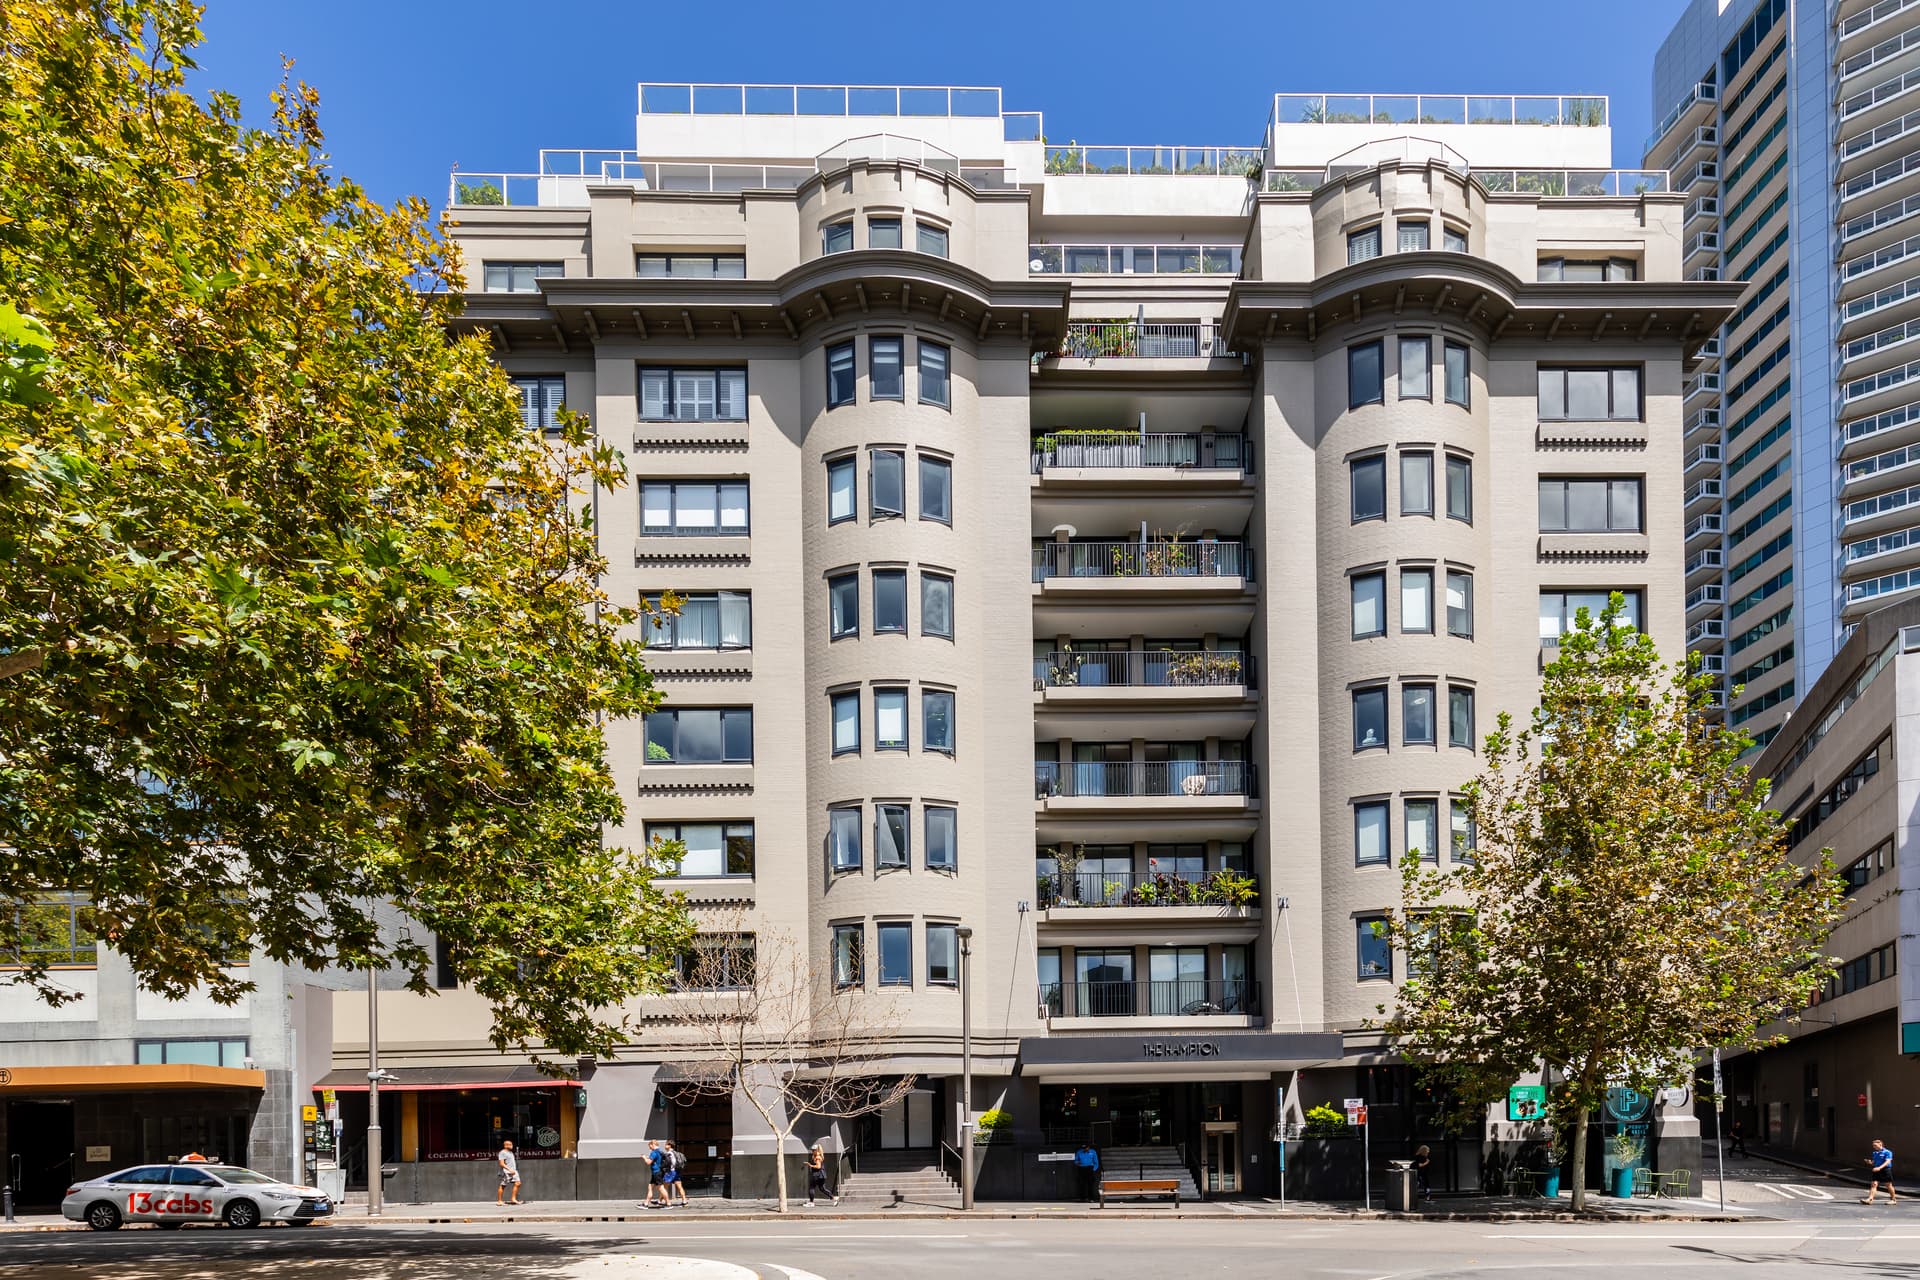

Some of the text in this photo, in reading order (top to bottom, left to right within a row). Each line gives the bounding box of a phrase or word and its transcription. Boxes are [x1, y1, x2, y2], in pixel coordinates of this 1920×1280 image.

[1143, 1042, 1220, 1057] THE HAMPTON
[127, 1192, 213, 1215] 13cabs
